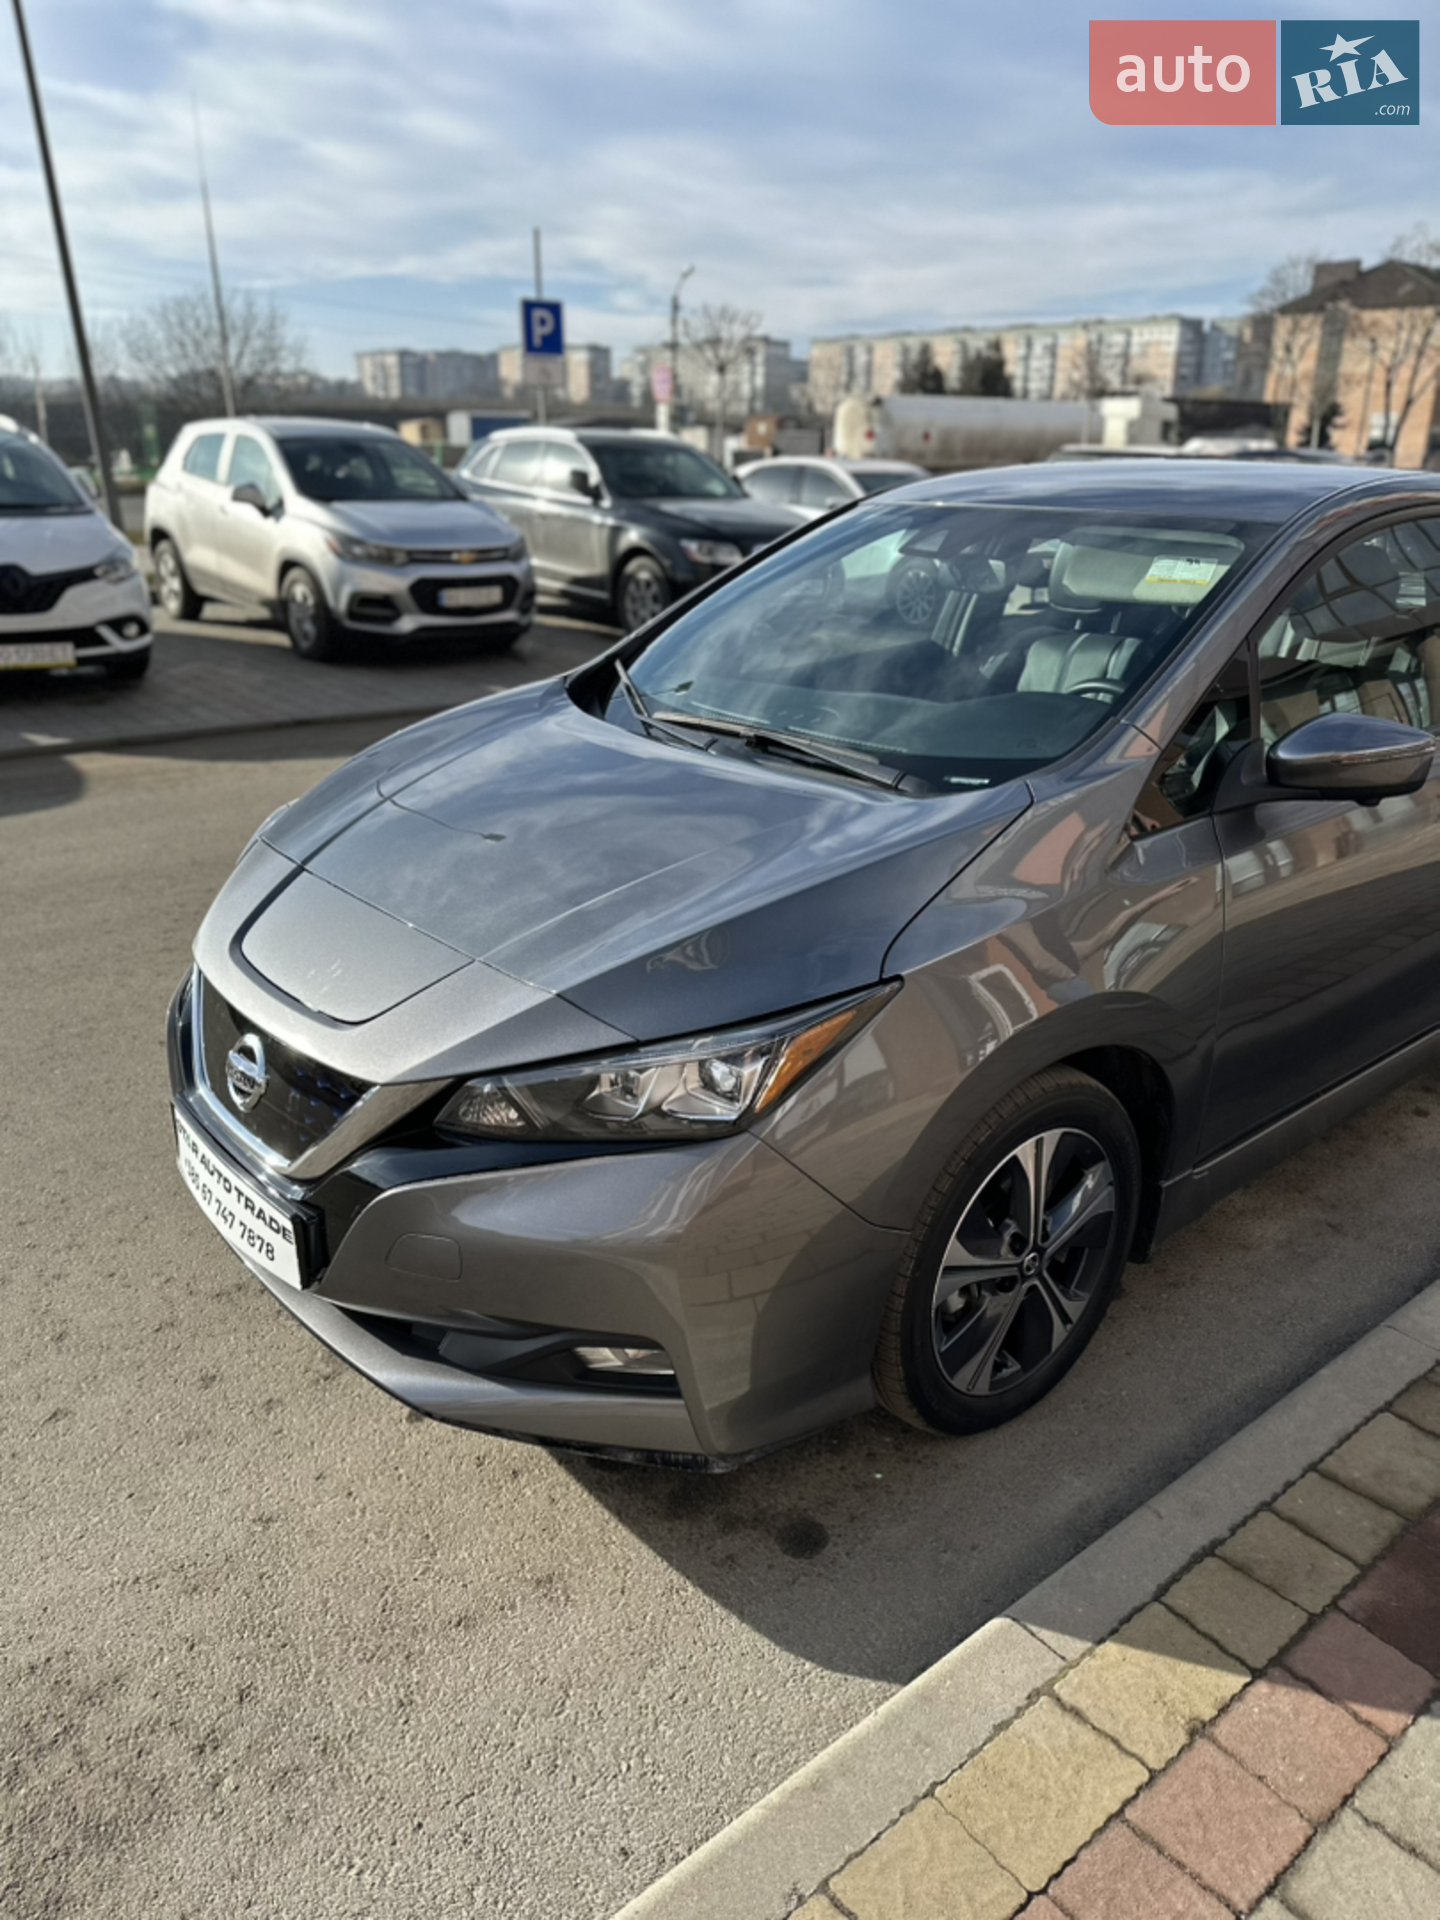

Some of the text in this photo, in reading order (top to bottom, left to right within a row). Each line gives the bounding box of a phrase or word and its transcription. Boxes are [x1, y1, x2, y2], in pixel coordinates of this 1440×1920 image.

[531, 307, 555, 349] P
[200, 1153, 232, 1194] AUTO
[234, 1185, 294, 1246] TRADE
[201, 1183, 213, 1206] 67
[215, 1197, 236, 1230] 747
[239, 1219, 275, 1262] 7878
